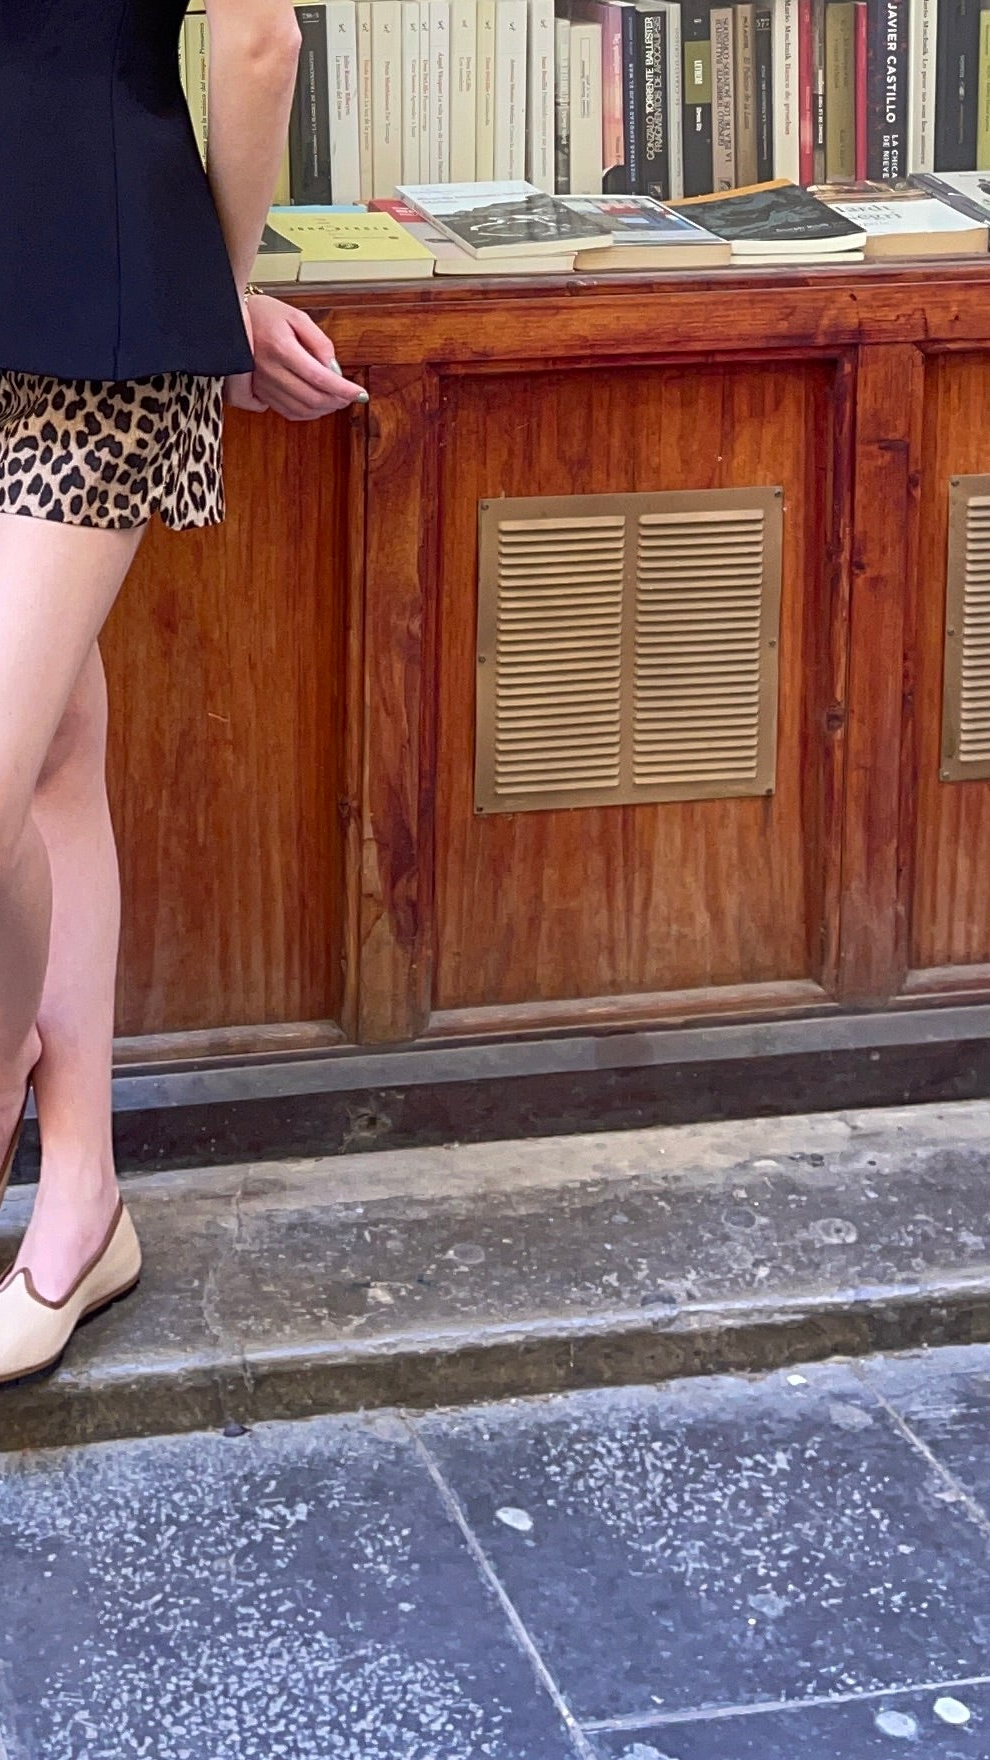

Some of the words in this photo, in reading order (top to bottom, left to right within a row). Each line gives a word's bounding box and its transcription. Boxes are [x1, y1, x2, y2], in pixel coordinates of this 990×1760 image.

[783, 0, 792, 23] Mario
[644, 16, 654, 66] BALLESTER
[886, 2, 899, 51] JAVIER
[645, 67, 655, 114] TORRENTE
[653, 75, 662, 88] DE
[885, 55, 898, 124] CASTILLO
[654, 90, 663, 153] FRAGMENTOS
[723, 100, 731, 118] LOS
[646, 115, 656, 161] GONZALO
[882, 134, 891, 148] DE
[891, 134, 899, 147] LA
[724, 152, 732, 163] LA
[882, 150, 891, 179] NIEVE
[891, 149, 899, 179] CHICA
